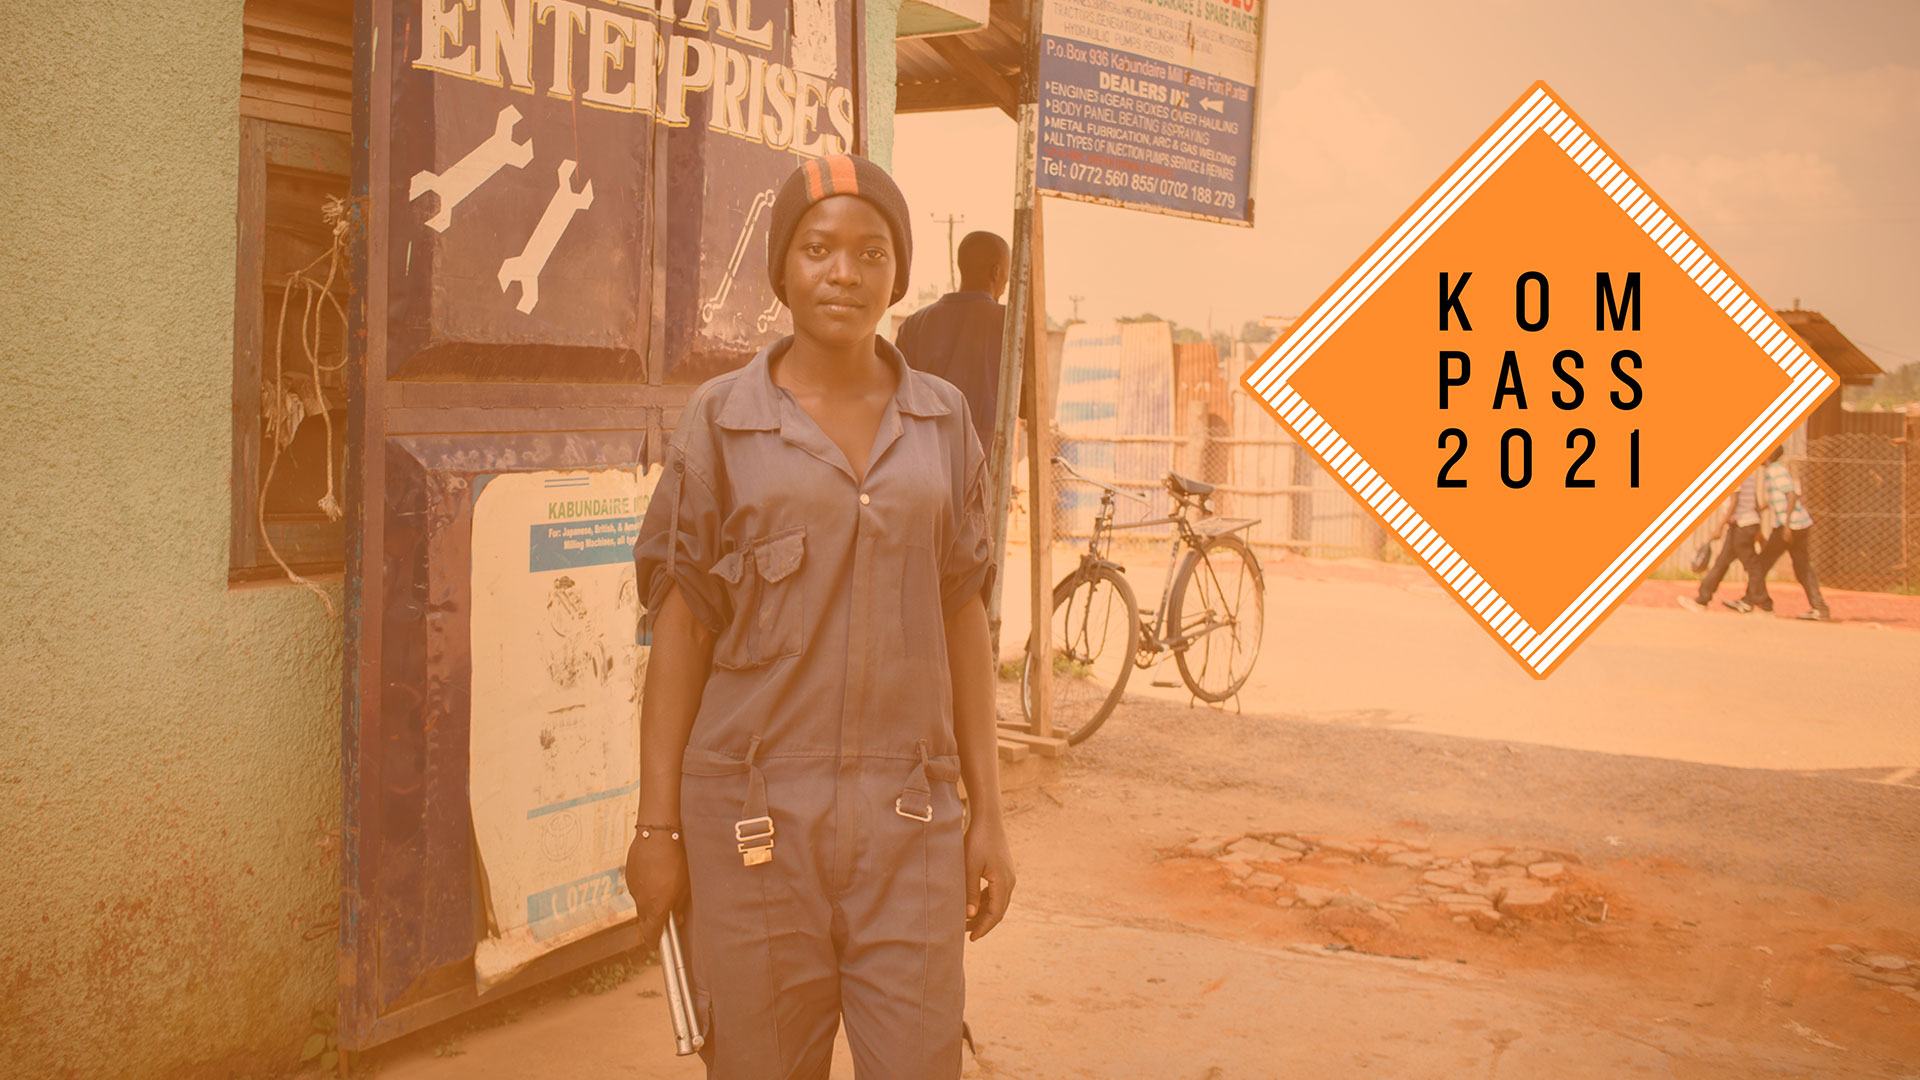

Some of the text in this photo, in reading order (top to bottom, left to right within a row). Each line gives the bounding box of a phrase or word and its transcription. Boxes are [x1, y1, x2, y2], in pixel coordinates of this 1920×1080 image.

[1089, 48, 1109, 68] 936
[1185, 70, 1206, 90] ane
[1099, 71, 1167, 103] DEALERS
[1051, 82, 1100, 102] ENGINES
[1136, 100, 1170, 120] BOXES
[1170, 108, 1198, 127] OVER
[1051, 99, 1083, 117] BODY
[1084, 104, 1117, 124] PANEL
[1118, 111, 1160, 133] BEATING
[1049, 132, 1065, 148] ALL
[1066, 133, 1093, 151] TYPES
[1094, 139, 1106, 153] OF
[1050, 117, 1084, 134] METAL
[1152, 134, 1172, 149] ARC
[1180, 139, 1198, 155] GAS
[1199, 147, 1238, 167] WELDING
[1041, 156, 1066, 178] Tel:
[1070, 163, 1102, 185] 0772
[1105, 170, 1128, 187] 560
[1160, 181, 1188, 200] 0702
[1191, 186, 1212, 204] 188
[1214, 190, 1236, 209] 279
[548, 498, 630, 520] KABUNDAIRE
[567, 875, 612, 914] 0772
